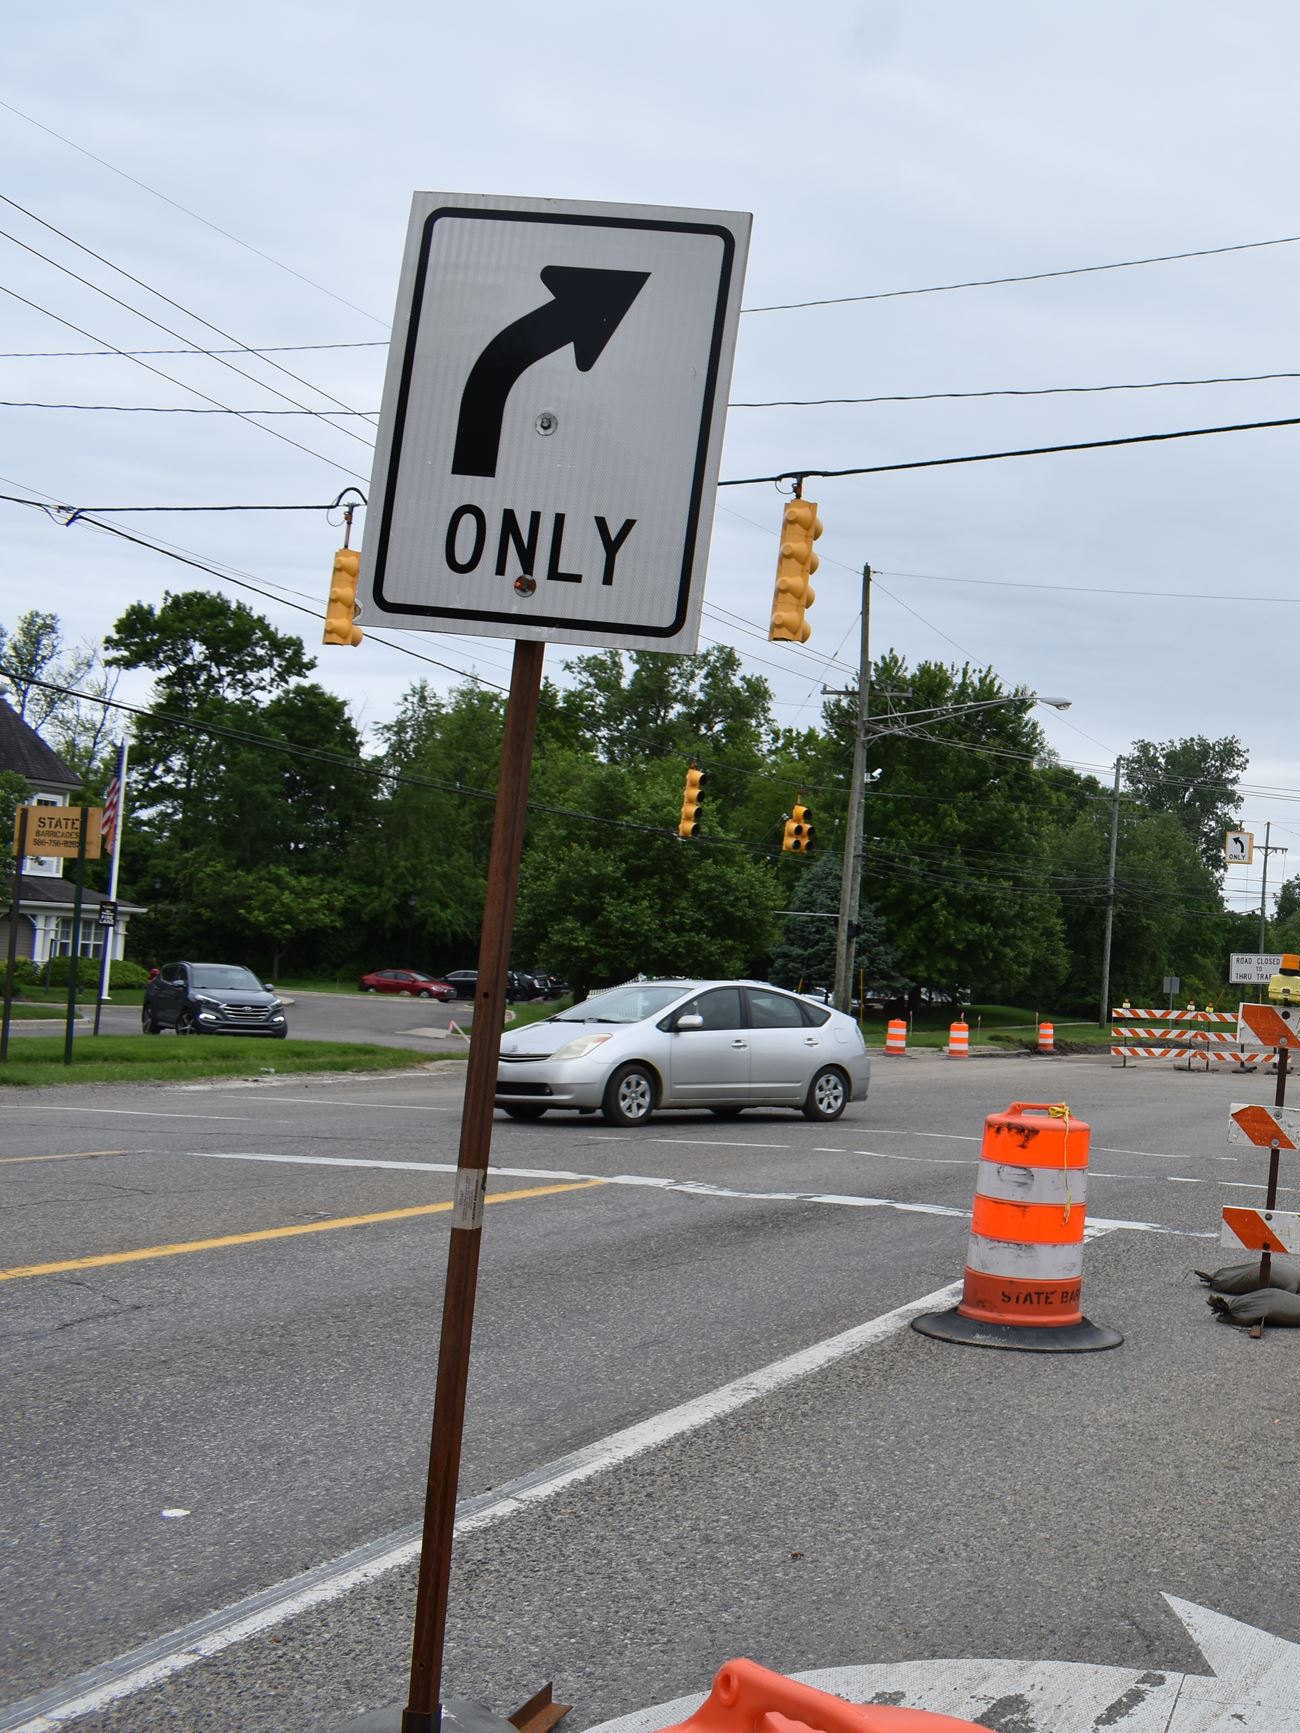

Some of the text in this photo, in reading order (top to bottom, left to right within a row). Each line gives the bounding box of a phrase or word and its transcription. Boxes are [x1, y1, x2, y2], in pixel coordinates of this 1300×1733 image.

[445, 504, 638, 586] ONLY
[38, 817, 80, 830] STATE
[35, 830, 80, 839] BARRICADES
[1001, 1290, 1057, 1305] STATE
